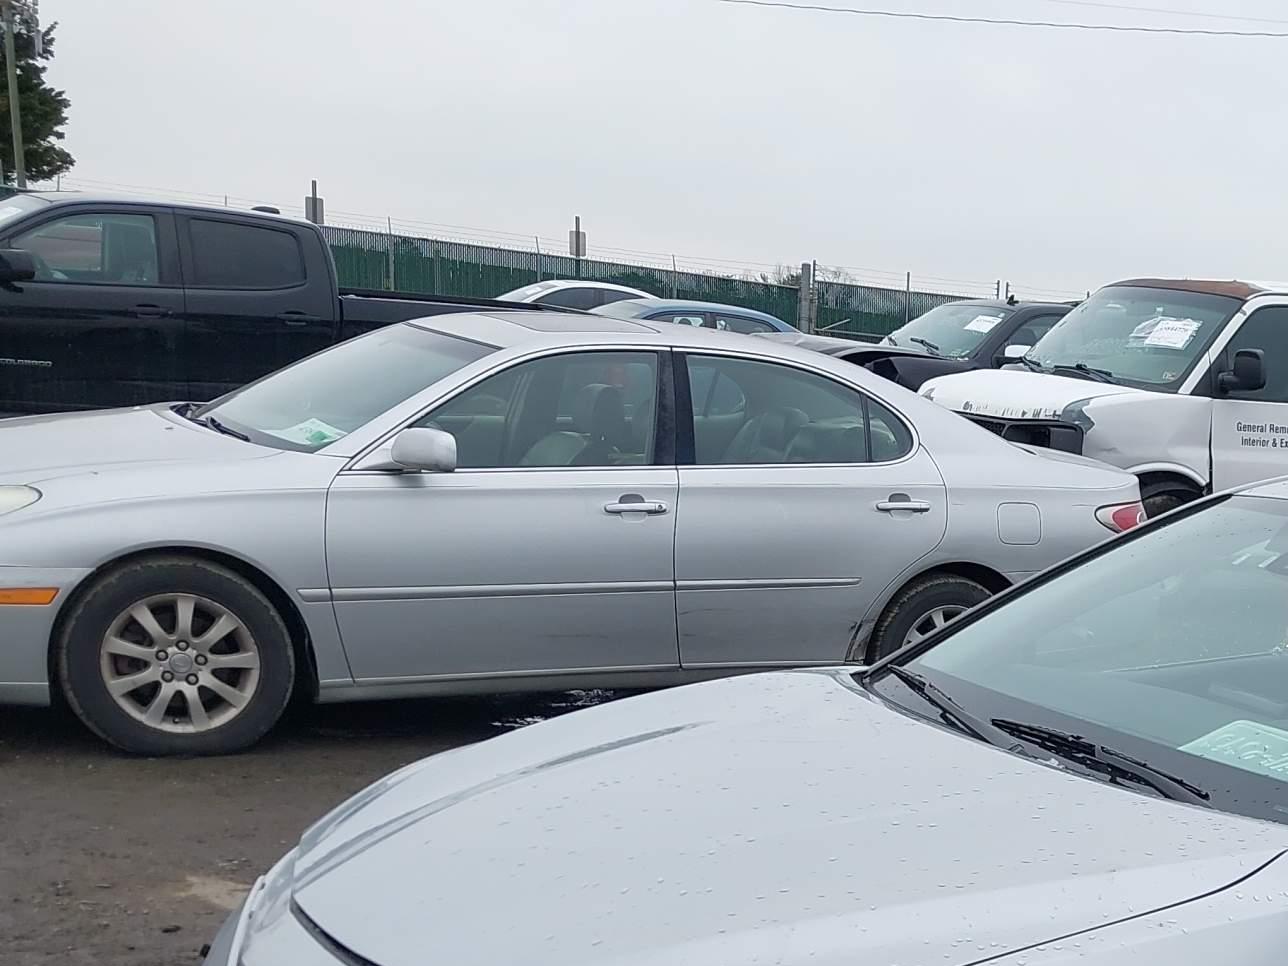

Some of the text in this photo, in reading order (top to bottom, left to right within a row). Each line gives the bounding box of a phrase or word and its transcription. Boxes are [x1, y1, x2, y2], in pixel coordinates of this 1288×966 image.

[1236, 421, 1267, 433] General
[1241, 436, 1269, 447] Interior
[1272, 438, 1277, 448] &
